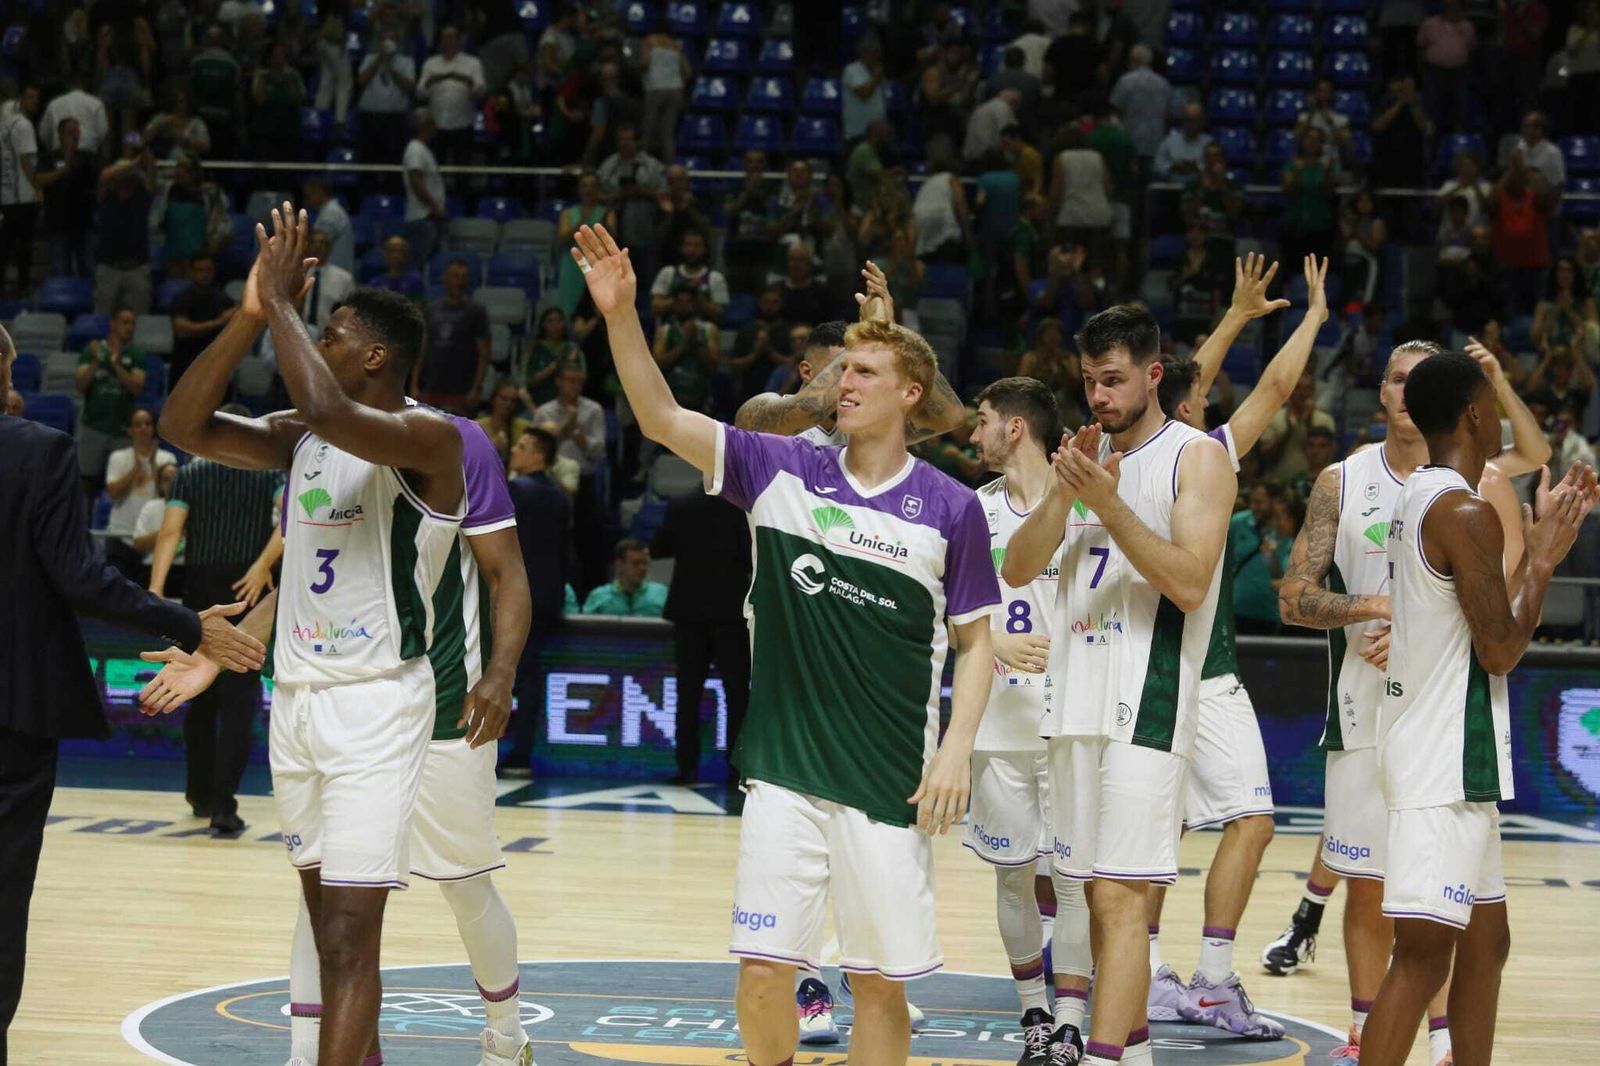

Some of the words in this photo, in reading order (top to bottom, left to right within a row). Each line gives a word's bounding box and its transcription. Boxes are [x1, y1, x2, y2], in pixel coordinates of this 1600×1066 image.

[849, 531, 908, 558] Unicaja
[309, 548, 340, 595] 3
[1088, 546, 1110, 589] 7
[831, 576, 859, 595] COSTA
[860, 589, 877, 603] DEL
[878, 597, 898, 610] SOL
[1005, 599, 1033, 634] 8
